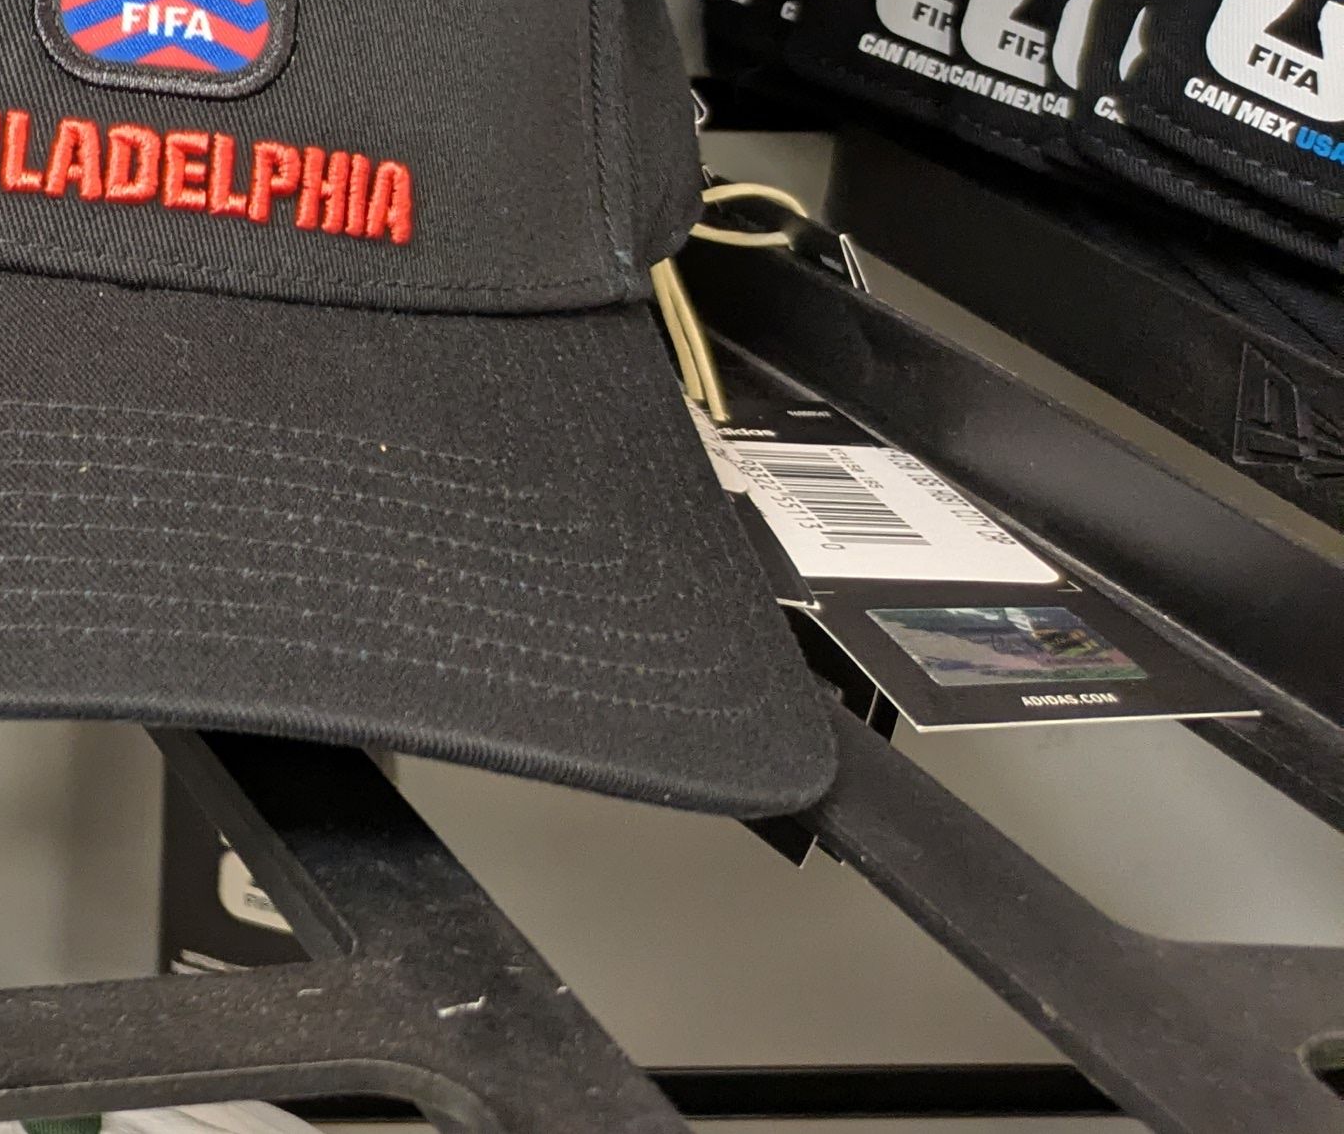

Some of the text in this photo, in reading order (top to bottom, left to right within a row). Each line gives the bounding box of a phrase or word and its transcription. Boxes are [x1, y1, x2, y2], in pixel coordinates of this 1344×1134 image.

[120, 1, 214, 42] FIFA
[913, 0, 955, 33] FIF
[858, 32, 904, 65] CAN
[997, 28, 1048, 65] FIF
[949, 65, 993, 97] CAN
[1247, 42, 1319, 96] FIFA
[1042, 91, 1070, 118] CA
[1183, 76, 1238, 116] CAN
[1234, 100, 1298, 143] MEX
[770, 495, 824, 529] 55113
[1020, 693, 1118, 707] ADIDAS.COM
